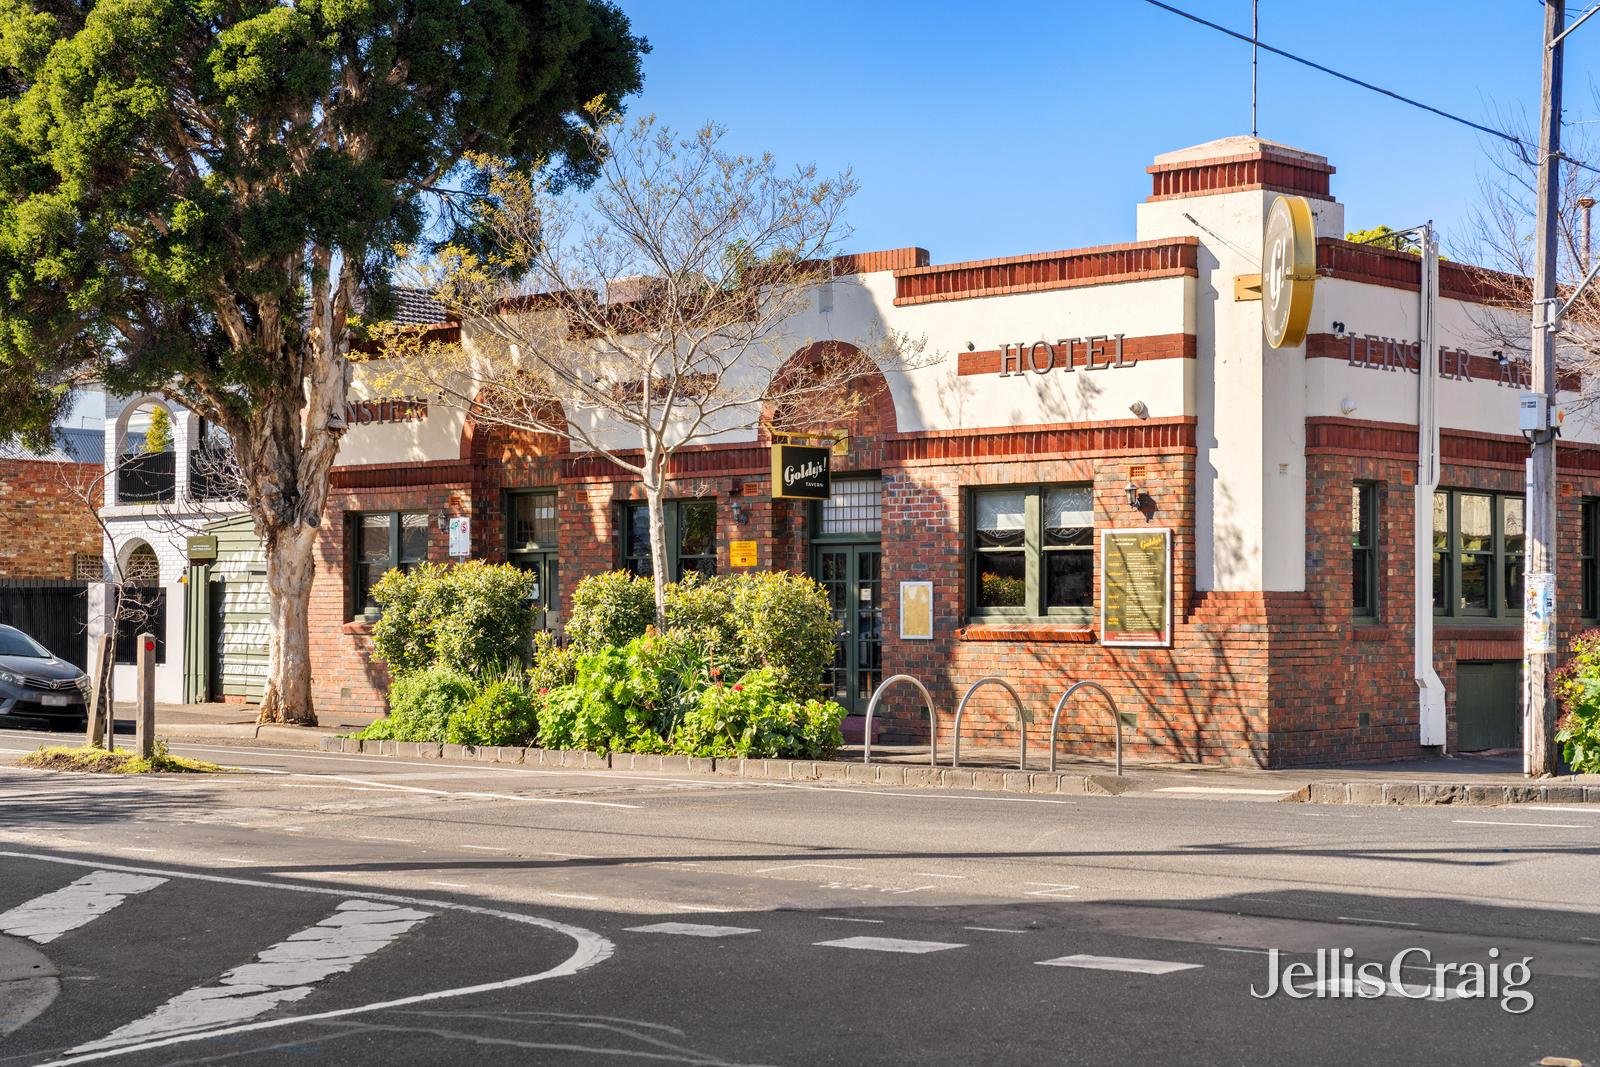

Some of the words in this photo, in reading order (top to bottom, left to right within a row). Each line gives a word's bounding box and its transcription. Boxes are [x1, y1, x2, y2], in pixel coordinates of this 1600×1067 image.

[999, 333, 1138, 377] HOTEL
[1348, 331, 1474, 382] LEINSER
[346, 395, 427, 425] NSTER
[784, 456, 827, 487] Goldy's!
